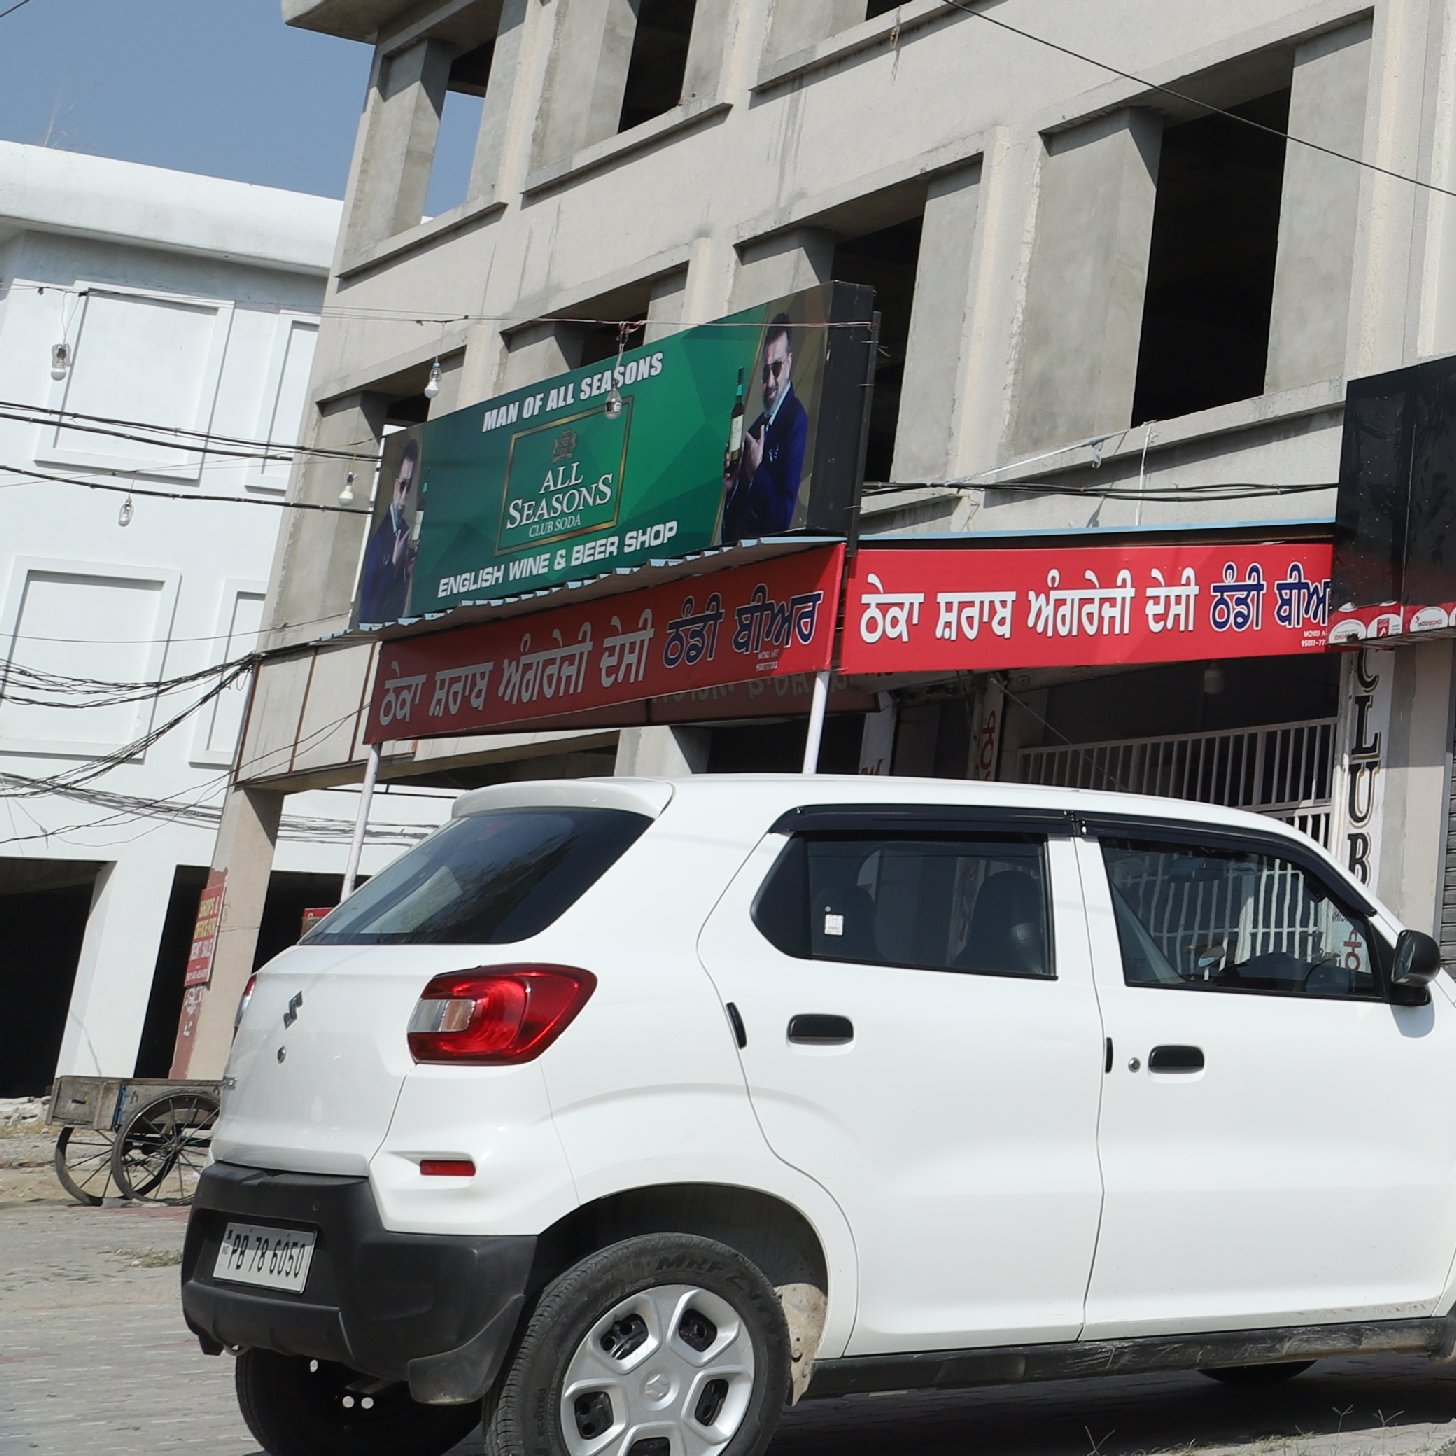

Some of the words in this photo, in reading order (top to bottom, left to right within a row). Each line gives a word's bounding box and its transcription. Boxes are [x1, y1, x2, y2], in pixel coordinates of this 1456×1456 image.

[482, 400, 519, 433] MAN
[522, 395, 545, 419] OF
[545, 382, 575, 412] ALL
[580, 351, 664, 401] SEASONS
[505, 472, 613, 530] SEASONS
[538, 461, 584, 495] ALL
[437, 563, 505, 599] ENGLISH
[508, 552, 551, 583] WINE
[553, 548, 567, 571] &
[570, 535, 620, 567] BEER
[623, 519, 679, 554] SHOP
[528, 521, 554, 538] CLUB
[555, 513, 582, 533] SODA
[859, 573, 924, 643] ਠੇਕਾ
[935, 591, 1016, 641] ਸ਼ਰਾਬ
[1145, 566, 1199, 634] ਦੇਸੀ
[1274, 561, 1331, 629] ਬੀਅ
[379, 661, 427, 726] ਠੇਕਾ
[429, 661, 494, 718] ਸ਼ਰਾਬ
[600, 608, 655, 688] ਦੇਸੀ
[732, 583, 824, 655] ਬੀਅਰ
[227, 1234, 249, 1271] PB
[247, 1236, 270, 1273] 78
[269, 1239, 306, 1279] 6050
